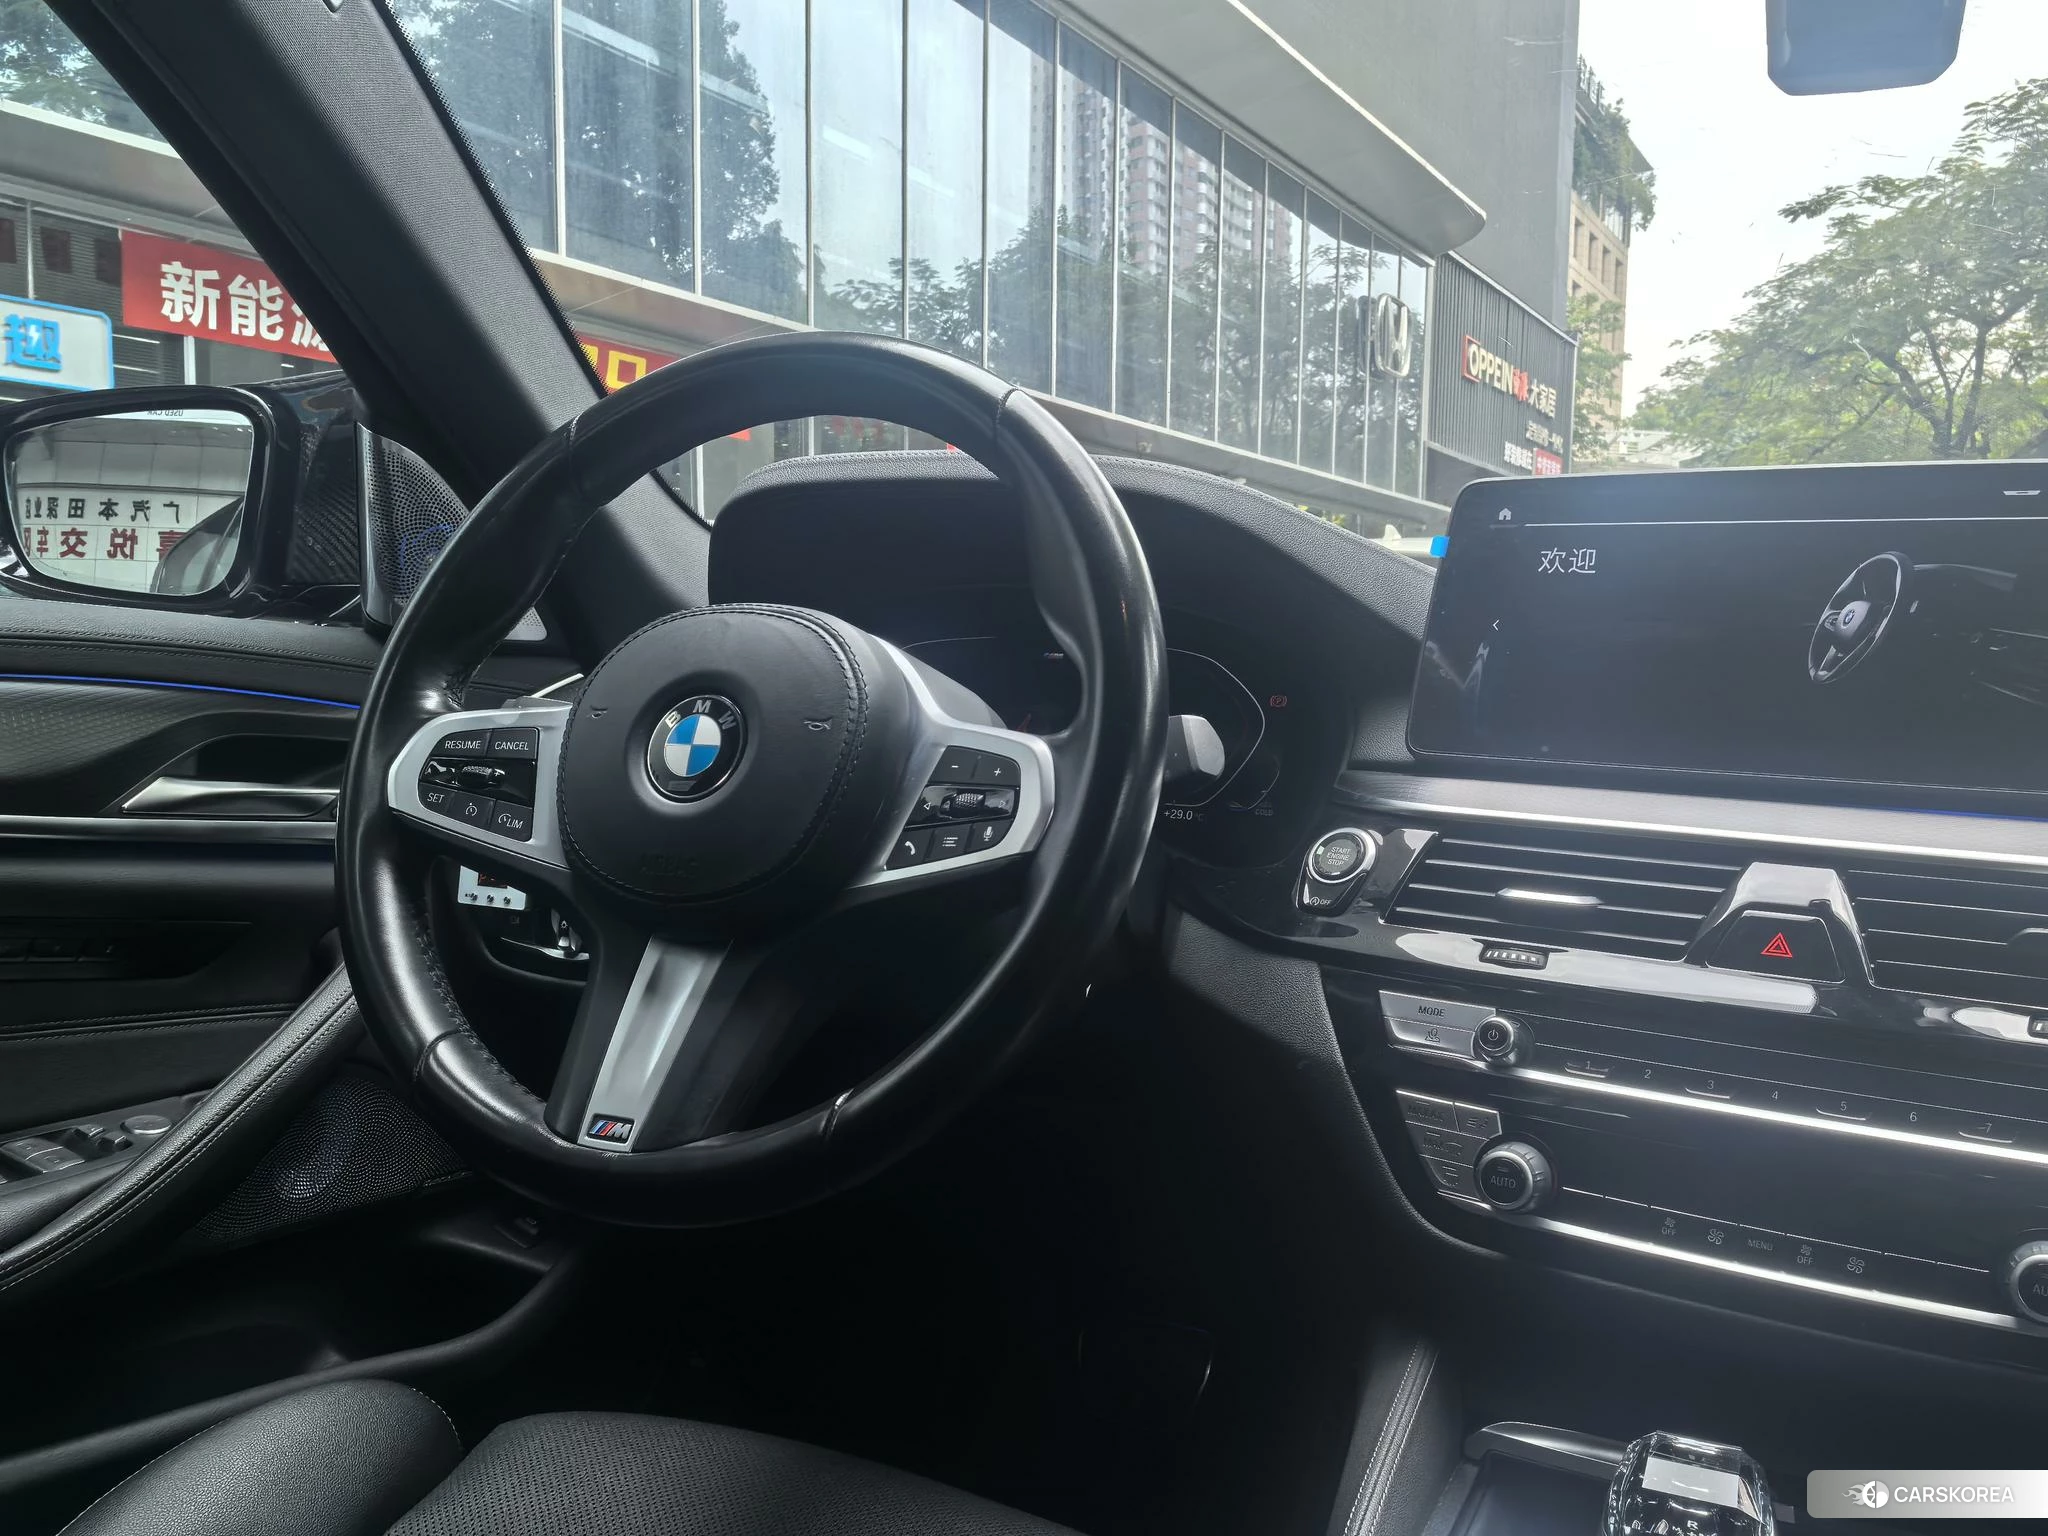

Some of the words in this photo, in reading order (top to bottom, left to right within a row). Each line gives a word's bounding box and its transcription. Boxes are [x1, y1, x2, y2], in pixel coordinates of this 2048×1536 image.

[1537, 547, 1597, 574] 欢迎
[664, 699, 737, 731] BMW
[444, 740, 482, 750] RESUME
[494, 741, 530, 751] CANCEL
[427, 792, 446, 804] SET
[506, 818, 524, 830] LIM
[1330, 846, 1351, 855] START
[1327, 858, 1345, 866] STOP
[1418, 1005, 1446, 1018] MODE
[1644, 1069, 1652, 1079] 2
[1706, 1080, 1714, 1089] 3
[1771, 1090, 1779, 1100] 4
[1840, 1101, 1848, 1111] 5
[1909, 1111, 1918, 1122] 6
[1490, 1175, 1516, 1189] AUTO
[1661, 1227, 1677, 1237] OFF
[1748, 1239, 1773, 1252] MENU
[1797, 1256, 1814, 1266] OFF
